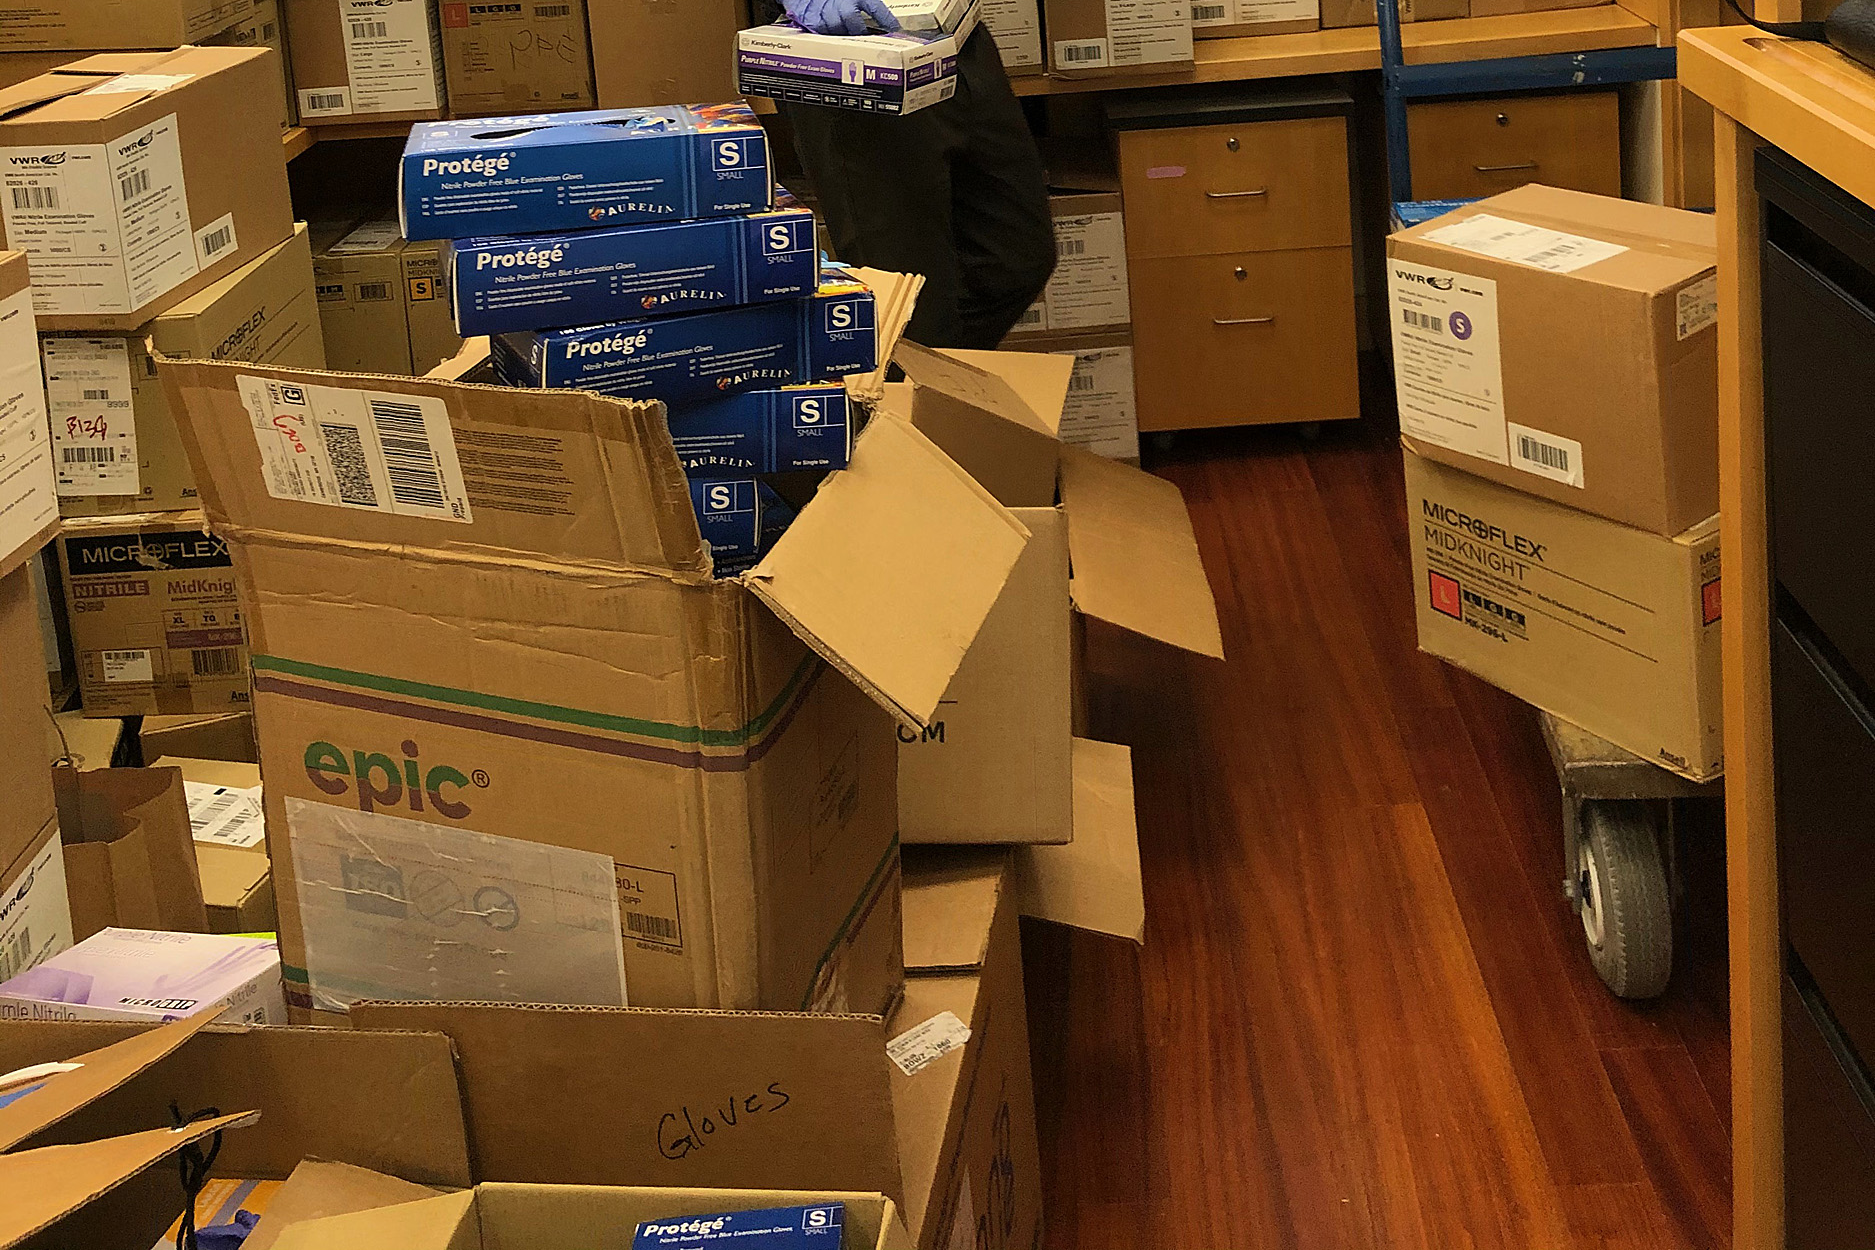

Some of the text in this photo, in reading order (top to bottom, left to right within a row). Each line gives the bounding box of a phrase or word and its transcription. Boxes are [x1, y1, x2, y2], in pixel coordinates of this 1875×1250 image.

[751, 40, 792, 50] Kimberly-Clark
[865, 68, 876, 80] M
[119, 142, 138, 156] VWR
[719, 141, 741, 166] S
[9, 156, 40, 165] VWR
[423, 152, 510, 177] Protégé
[441, 172, 584, 191] Nitrile Powder Free Blue Examination Gloves
[716, 171, 744, 181] SMALL
[724, 203, 739, 212] Single
[769, 226, 790, 250] S
[476, 244, 564, 271] Protégé
[767, 254, 795, 265] SMALL
[494, 262, 637, 284] Nitrile Powder Free Blue Examination Gloves
[1395, 269, 1426, 285] VWR
[415, 282, 427, 294] S
[774, 287, 789, 296] Single
[832, 304, 852, 327] S
[1456, 318, 1466, 335] S
[566, 328, 648, 360] Protégé
[829, 331, 854, 342] SMALL
[582, 344, 714, 371] Nitrile Powder Free Blue Examination Gloves
[836, 364, 850, 372] Single
[800, 400, 821, 424] S
[797, 428, 823, 437] SMALL
[710, 485, 731, 510] S
[707, 514, 733, 524] SMALL
[1422, 498, 1547, 563] MICROFLEX
[82, 540, 229, 565] MICROFLEX
[1424, 524, 1530, 581] MIDKNIGHT
[74, 581, 147, 597] NITRILE
[1440, 585, 1451, 604] L
[173, 616, 185, 624] XL
[656, 1081, 790, 1160] Gloves
[643, 1215, 725, 1237] Protégé
[809, 1210, 827, 1227] S
[659, 1225, 794, 1244] Nitrile Powder Free Blue Examination Gloves
[804, 1227, 828, 1236] SMALL
